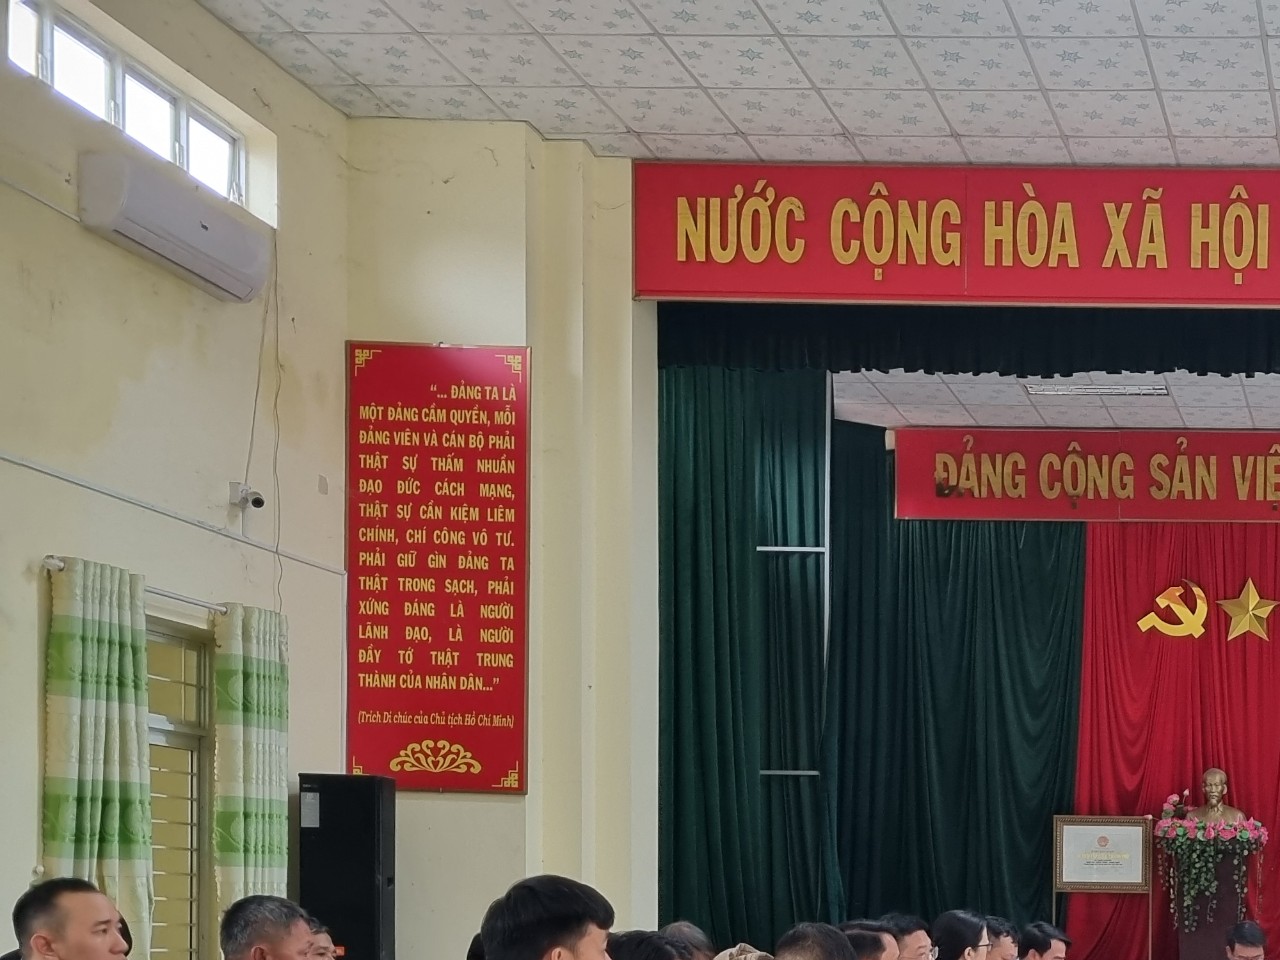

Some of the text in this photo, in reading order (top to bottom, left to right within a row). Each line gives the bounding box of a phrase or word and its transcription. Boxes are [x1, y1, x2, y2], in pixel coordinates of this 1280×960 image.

[677, 179, 805, 264] NƯỚC
[831, 183, 961, 280] CỘNG
[984, 183, 1079, 269] HÒA
[1102, 188, 1168, 269] XÃ
[1190, 185, 1268, 284] HỘI
[451, 380, 481, 399] ĐẢNG
[485, 387, 498, 400] TA
[503, 384, 516, 400] LÀ
[360, 402, 515, 427] MỘT ĐẢNG CẦM QUYỀN, MỖI
[360, 425, 514, 450] ĐẢNG VIÊN VÀ CÁN BỘ PHẢI
[359, 452, 515, 473] THẬT SỰ THẤM NHUẦN
[934, 435, 1025, 499] ĐẢNG
[1039, 442, 1135, 509] CỘNG
[1149, 437, 1217, 500] SẢN
[359, 477, 515, 500] ĐẠO ĐỨC CÁCH MẠNG,
[359, 500, 514, 523] THẬT SỰ CẦN KIỆM LIÊM
[359, 525, 515, 546] CHÍNH, CHÍ CÔNG VÔ TƯ.
[359, 548, 514, 570] PHẢI GIỮ GÌN ĐẢNG TA
[359, 574, 513, 595] THẬT TRONG SẠCH, PHẢI
[359, 598, 513, 619] XỨNG ĐÁNG LÀ NGƯỜI
[359, 622, 513, 643] LÃNH ĐẠO, LÀ NGƯỜI
[359, 644, 513, 668] ĐẦY TỚ THẬT TRUNG
[359, 671, 395, 688] THÀNH
[400, 670, 422, 689] CỦA
[426, 673, 456, 690] NHÂN
